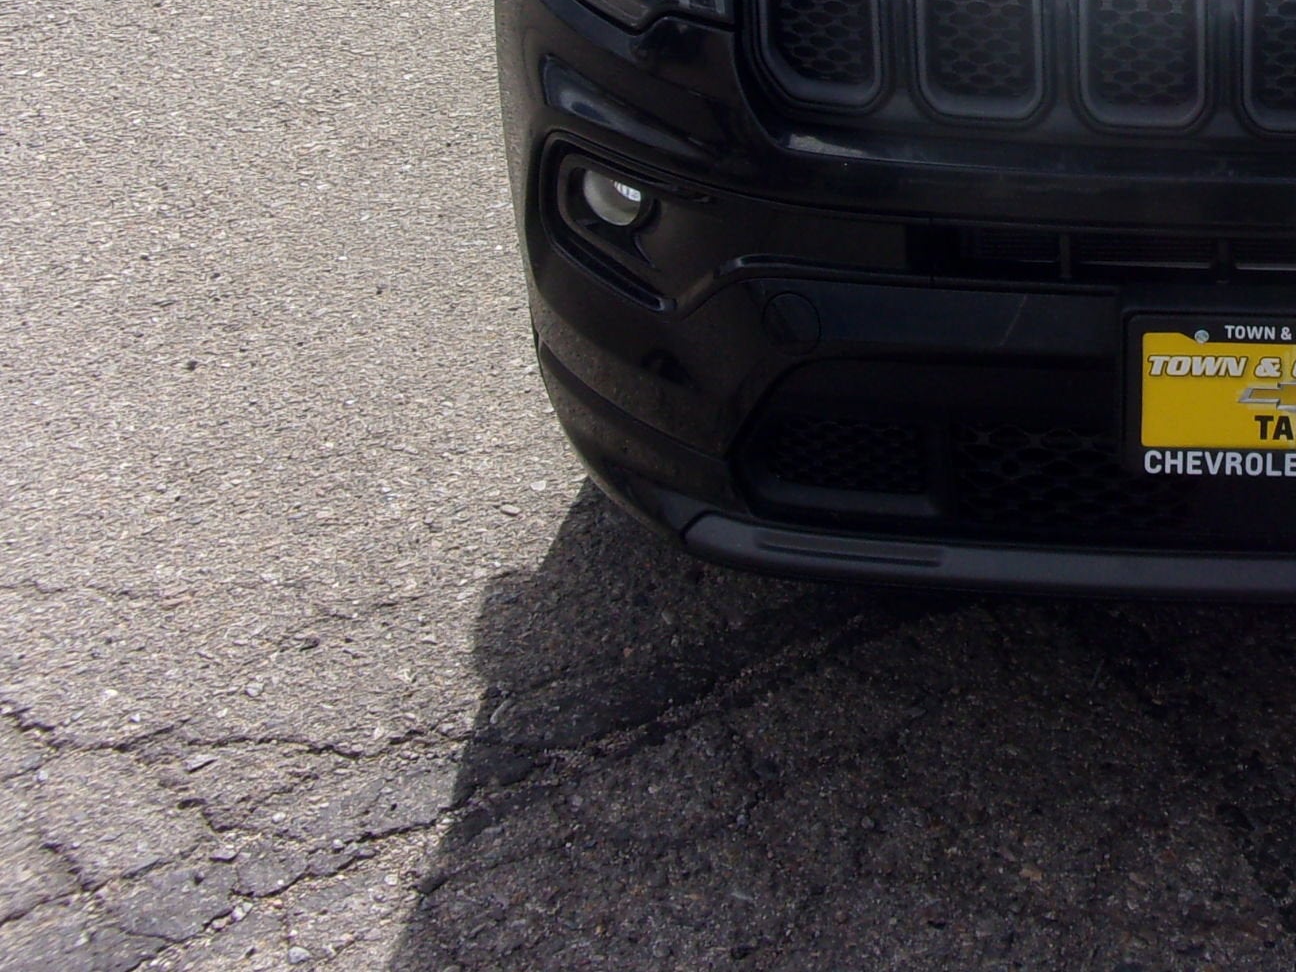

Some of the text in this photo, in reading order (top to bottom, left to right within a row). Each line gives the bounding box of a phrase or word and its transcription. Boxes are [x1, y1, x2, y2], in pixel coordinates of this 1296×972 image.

[1224, 324, 1276, 340] TOWN
[1281, 327, 1292, 340] &
[1148, 355, 1248, 378] TOWN
[1254, 357, 1282, 378] &
